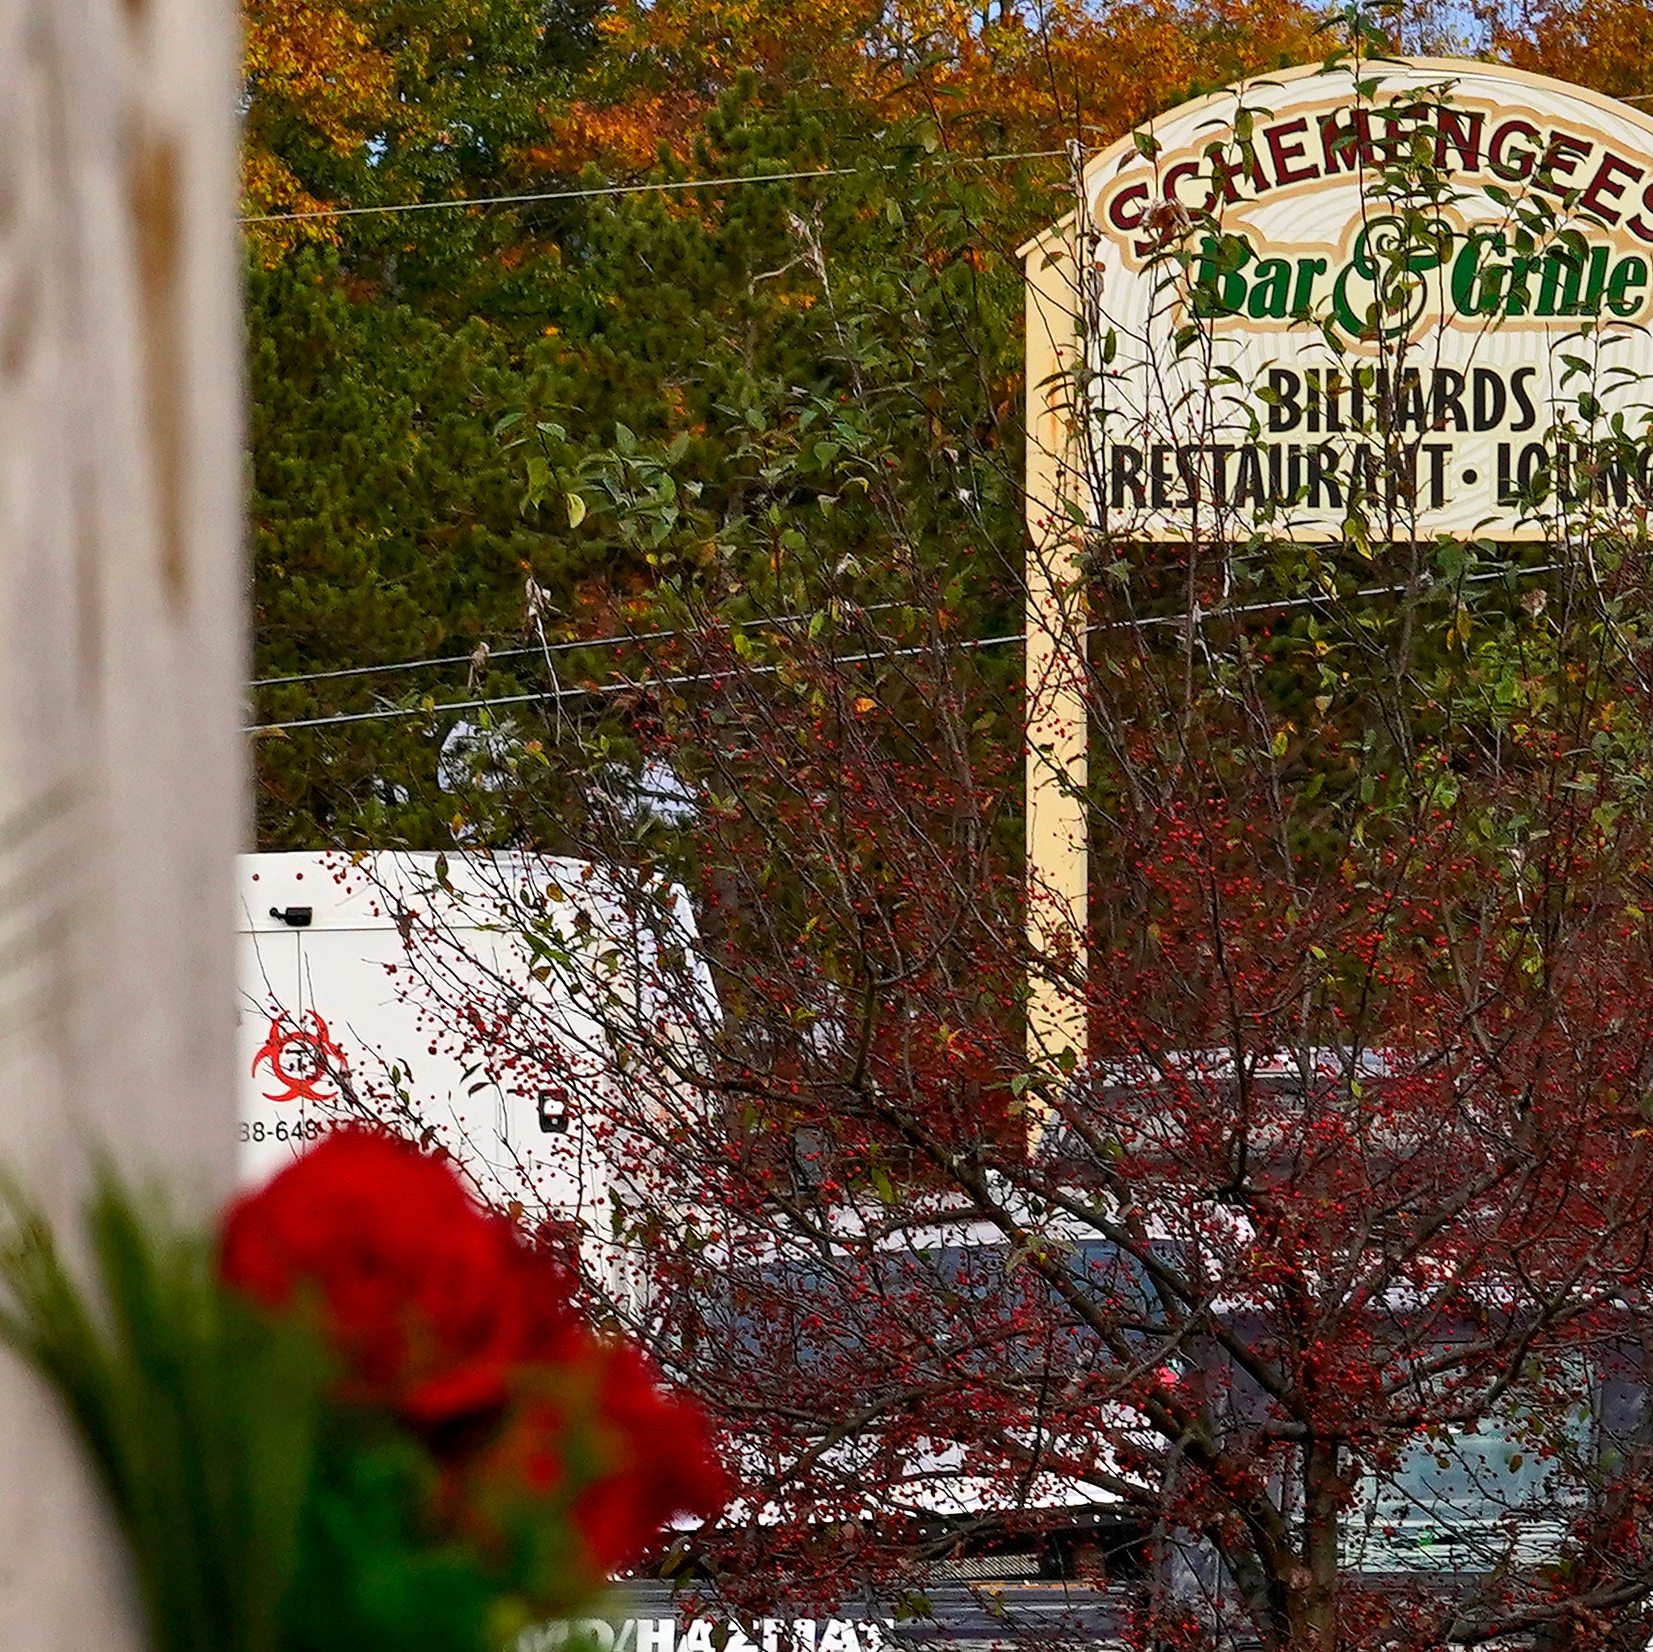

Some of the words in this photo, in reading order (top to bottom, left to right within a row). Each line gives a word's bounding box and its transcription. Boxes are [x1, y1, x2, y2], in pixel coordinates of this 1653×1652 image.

[1188, 234, 1327, 319] Bar
[1333, 215, 1451, 340] &
[1451, 233, 1647, 316] Grille
[1269, 367, 1536, 432] BILLIARDS
[1110, 443, 1453, 509] RESTAURANT
